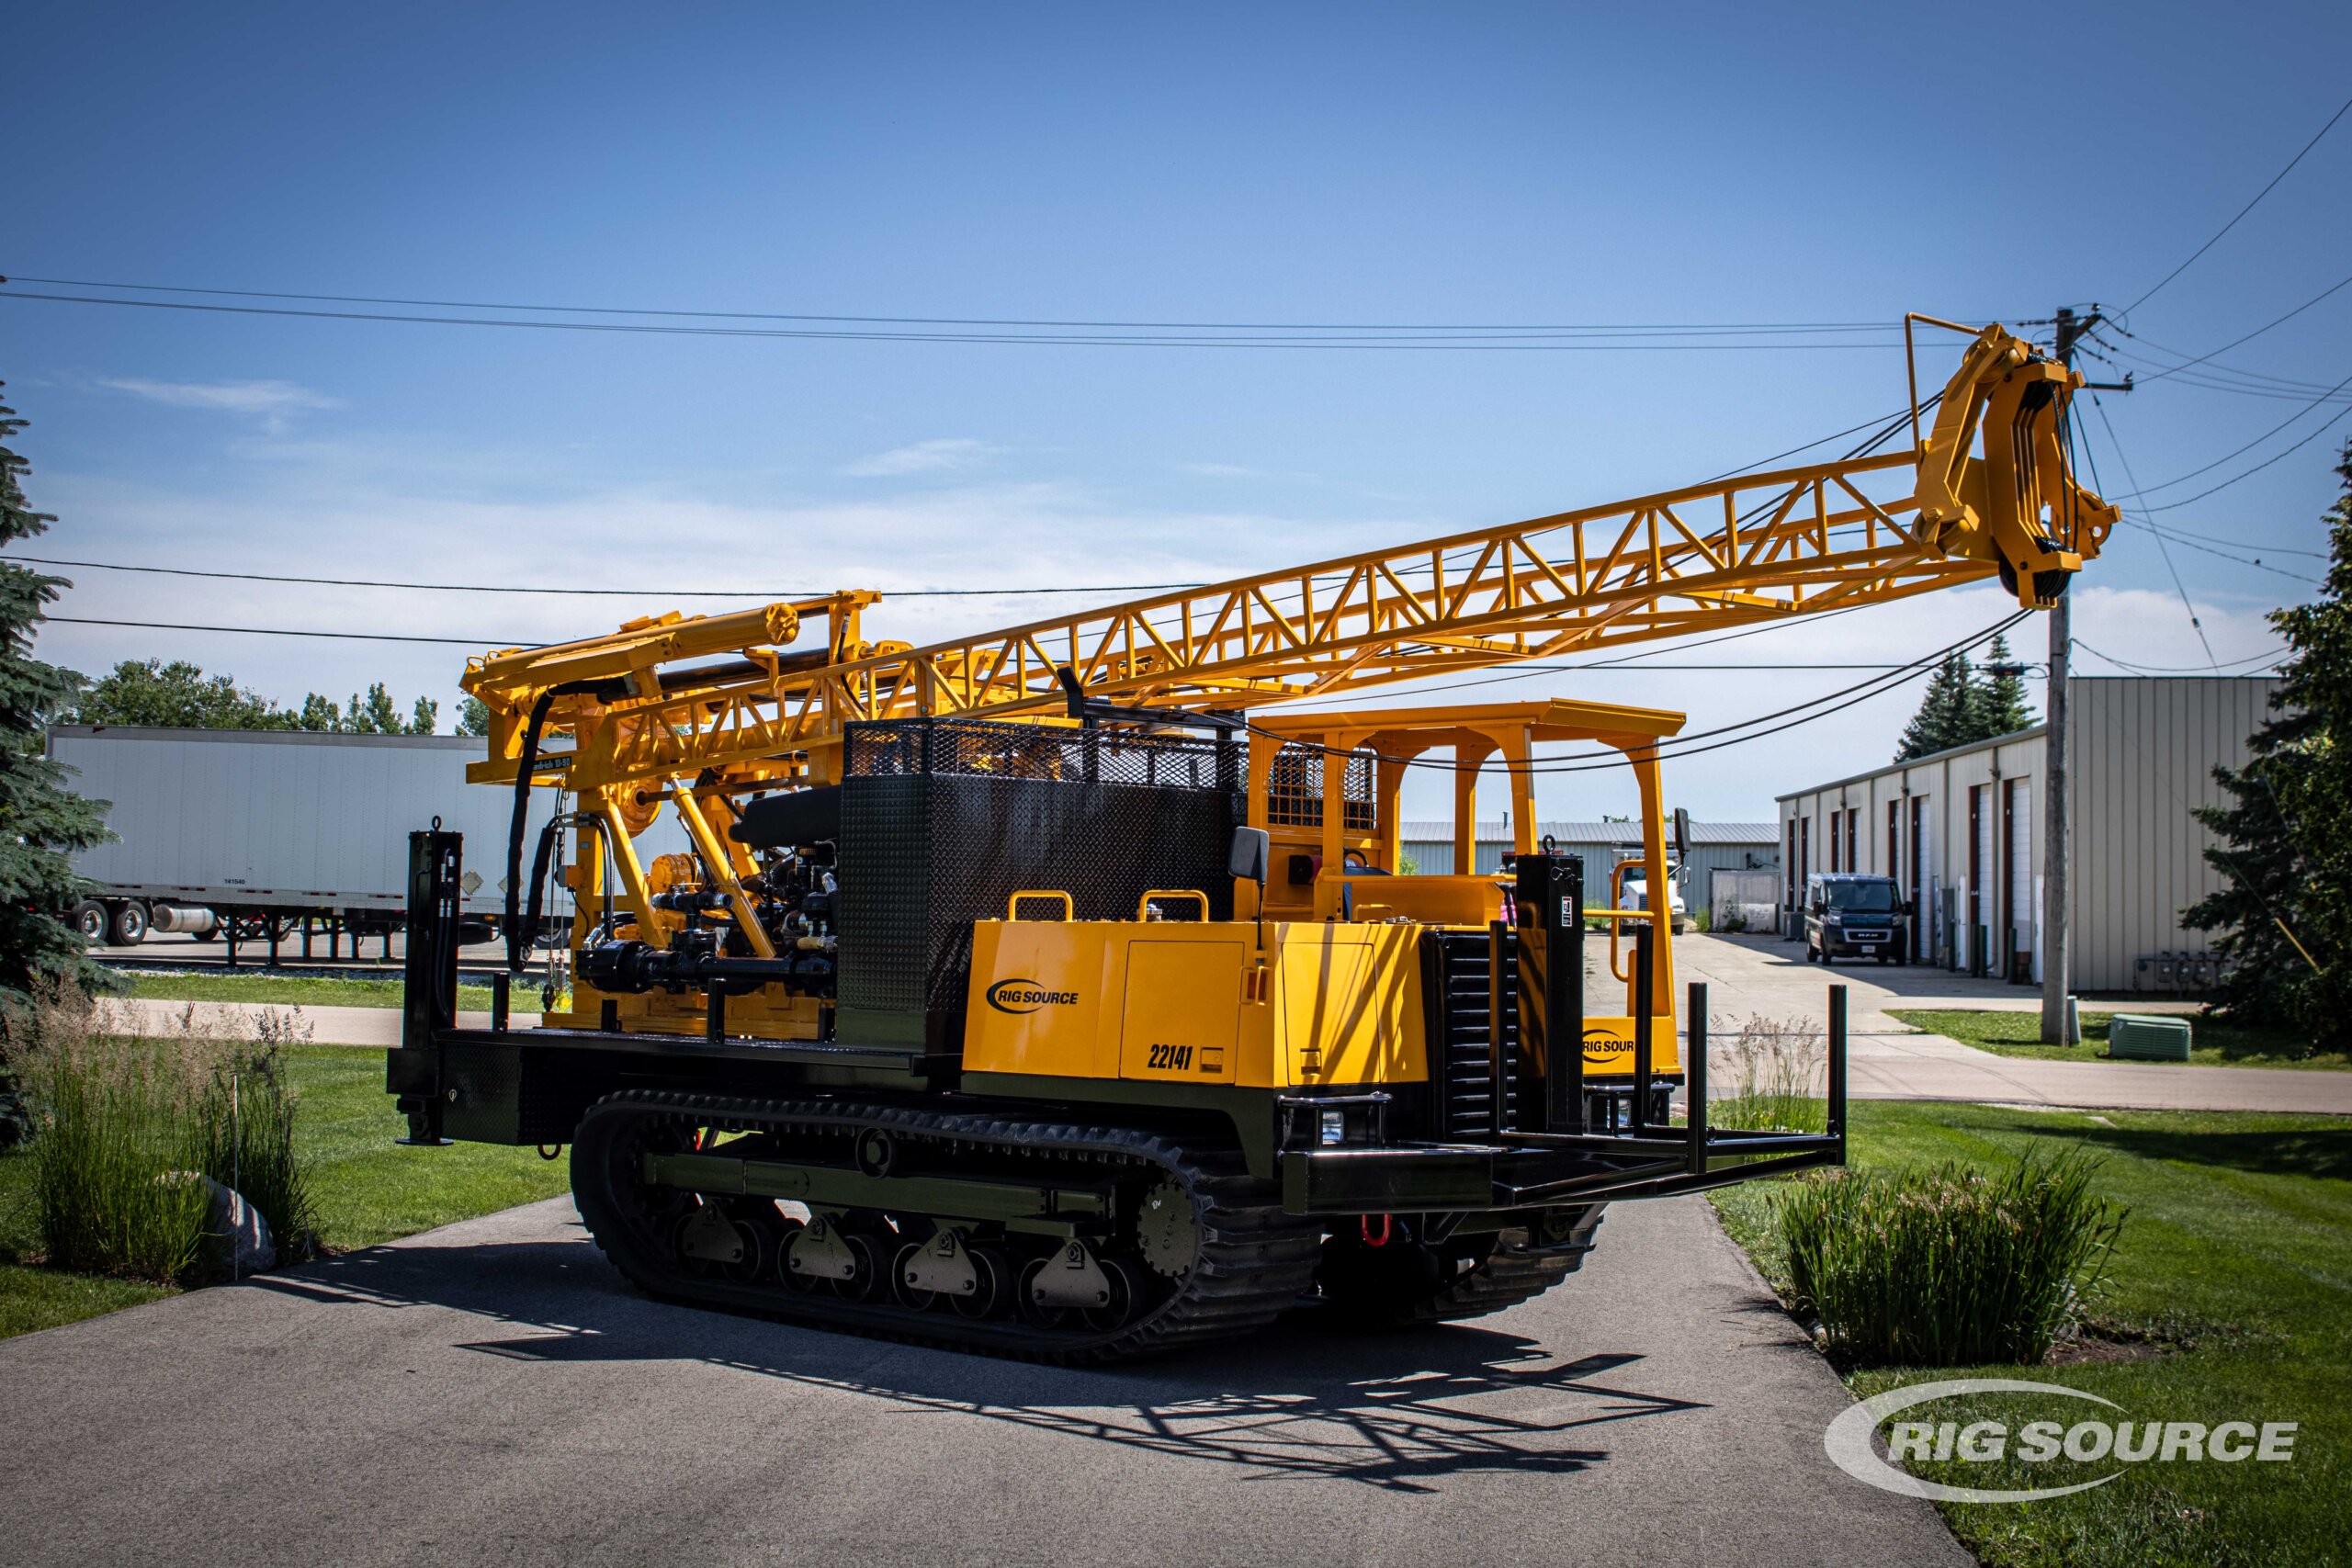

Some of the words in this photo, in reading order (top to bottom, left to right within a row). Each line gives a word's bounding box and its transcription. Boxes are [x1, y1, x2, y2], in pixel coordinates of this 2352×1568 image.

[998, 990, 1022, 1003] RIG
[1023, 991, 1079, 1005] SOURCE
[1582, 1040, 1602, 1053] RIG
[1603, 1040, 1634, 1053] SOUR
[1147, 1043, 1193, 1070] 22141
